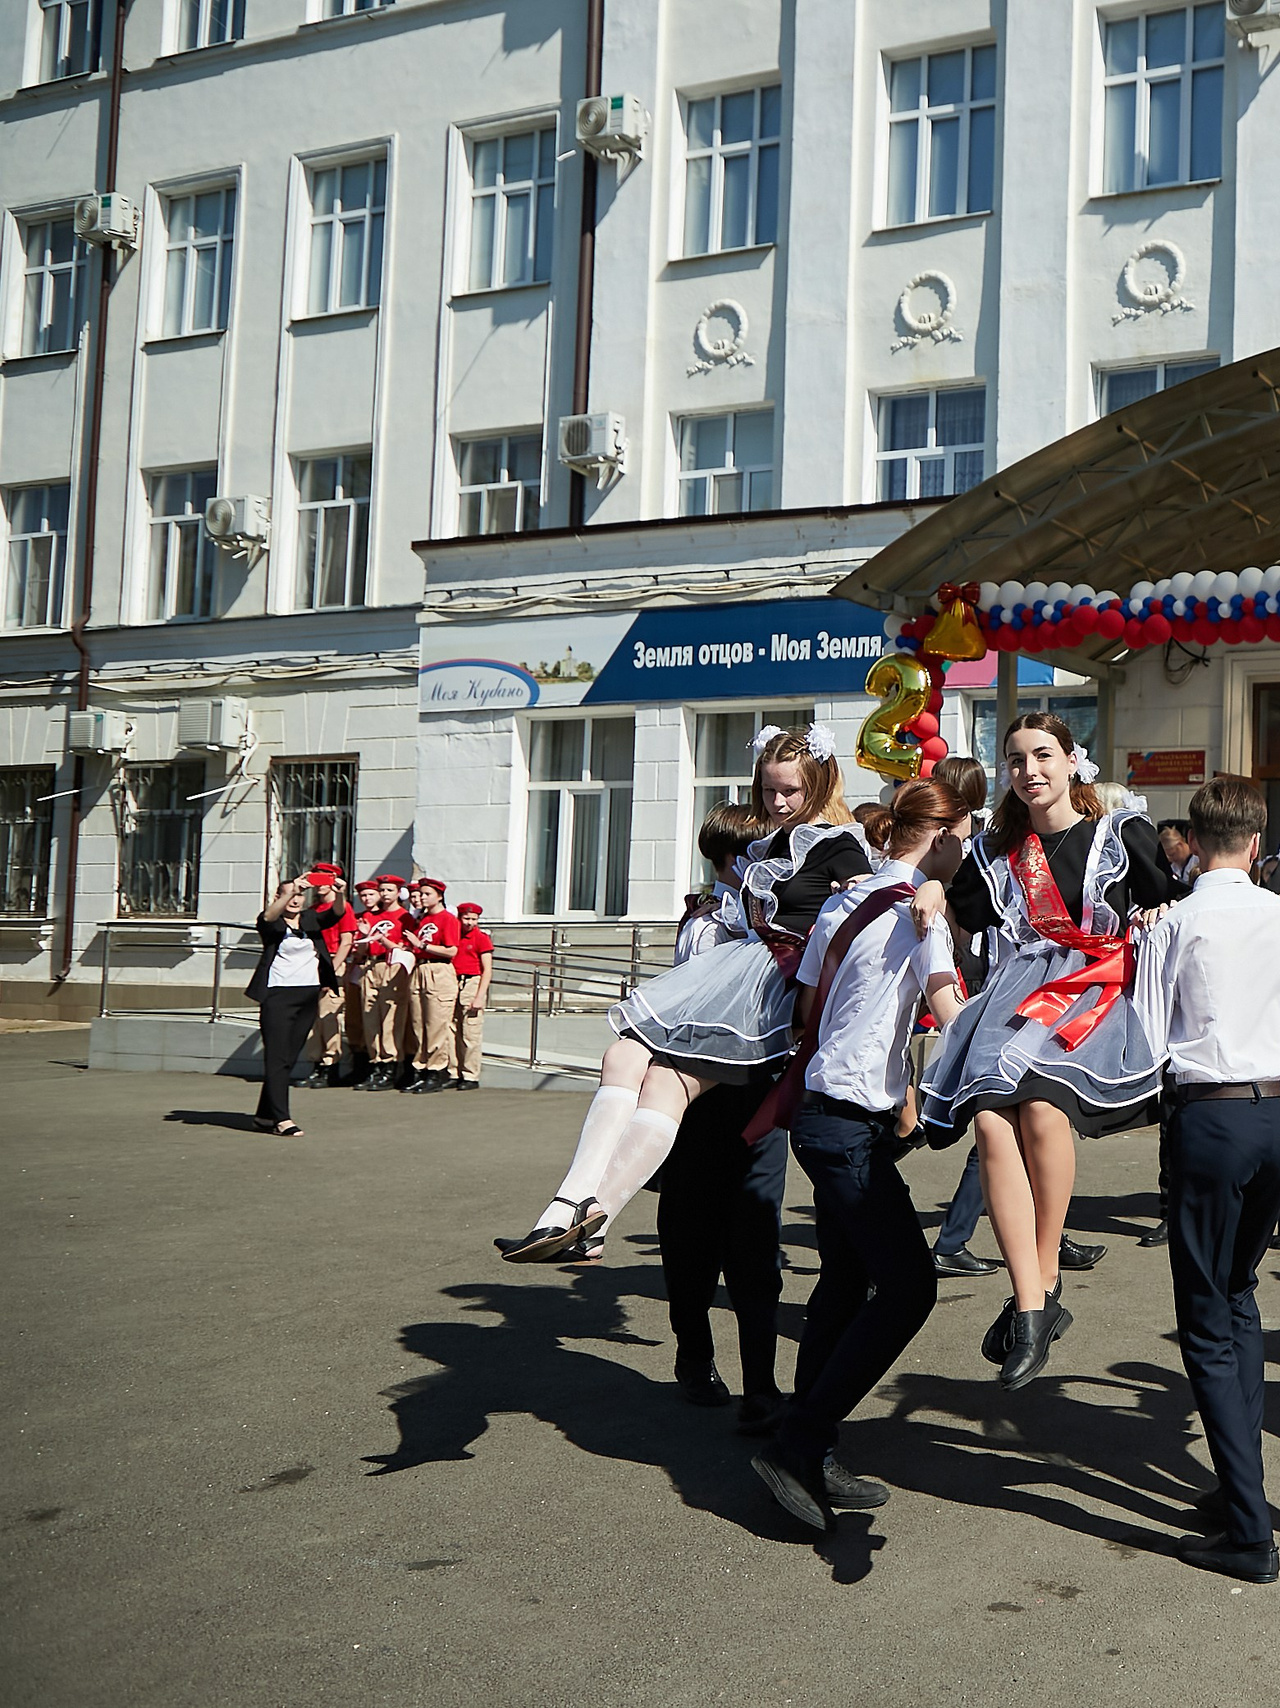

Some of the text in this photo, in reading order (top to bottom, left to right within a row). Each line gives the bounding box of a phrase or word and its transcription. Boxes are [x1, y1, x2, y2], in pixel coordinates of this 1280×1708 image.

[633, 641, 693, 669] Земля
[698, 642, 754, 669] отцов
[770, 633, 811, 662] Моя
[427, 677, 524, 706] Моя Кубань
